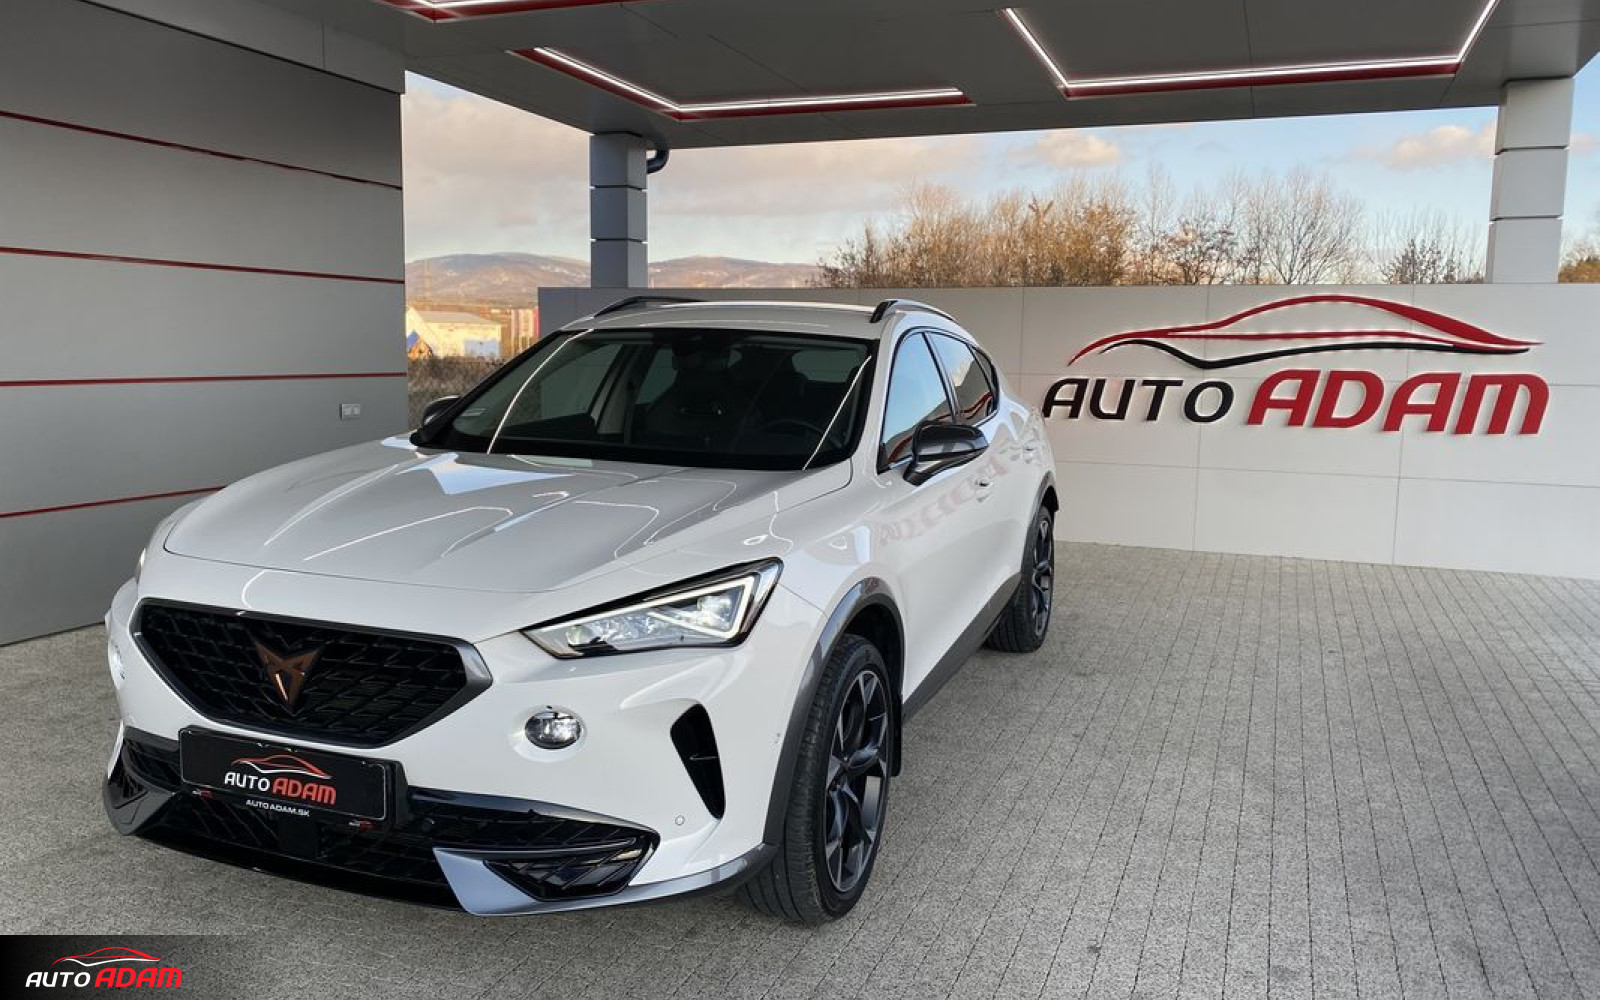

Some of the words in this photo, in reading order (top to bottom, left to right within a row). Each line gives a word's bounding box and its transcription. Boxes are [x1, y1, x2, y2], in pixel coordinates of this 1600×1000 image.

[1042, 378, 1234, 423] AUTO
[1247, 369, 1550, 435] ADAM
[224, 772, 270, 791] AUTO
[273, 778, 336, 804] ADAM
